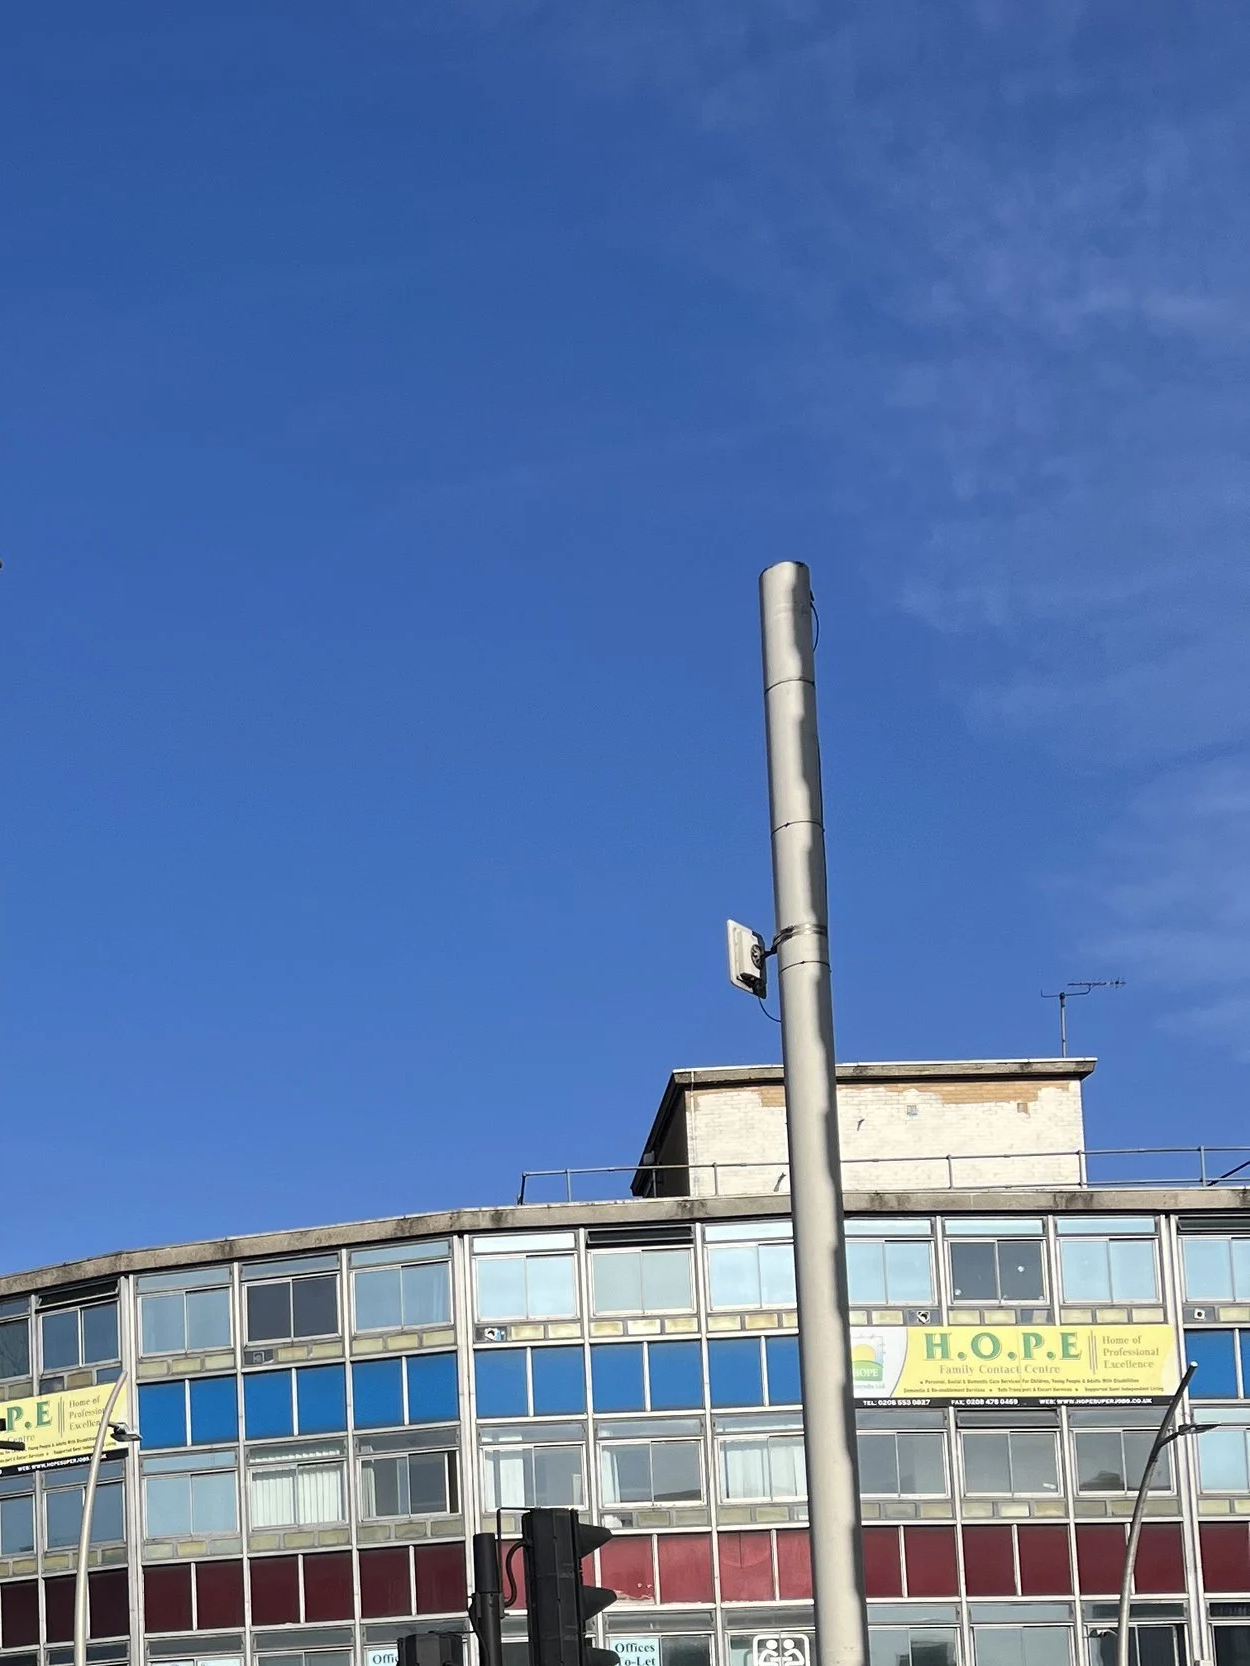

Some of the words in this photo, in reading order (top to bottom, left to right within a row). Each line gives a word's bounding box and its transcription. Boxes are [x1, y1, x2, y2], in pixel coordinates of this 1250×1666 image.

[1102, 1336, 1129, 1344] Home
[1132, 1335, 1141, 1344] of
[924, 1332, 1083, 1361] H.O.P.E
[1103, 1348, 1160, 1357] Professional
[1104, 1360, 1154, 1369] Excellence
[940, 1365, 974, 1375] Family
[979, 1365, 1021, 1374] Contact
[1025, 1365, 1061, 1374] Centre
[69, 1399, 90, 1408] Home
[69, 1407, 106, 1419] Professio
[615, 1643, 655, 1653] Offices
